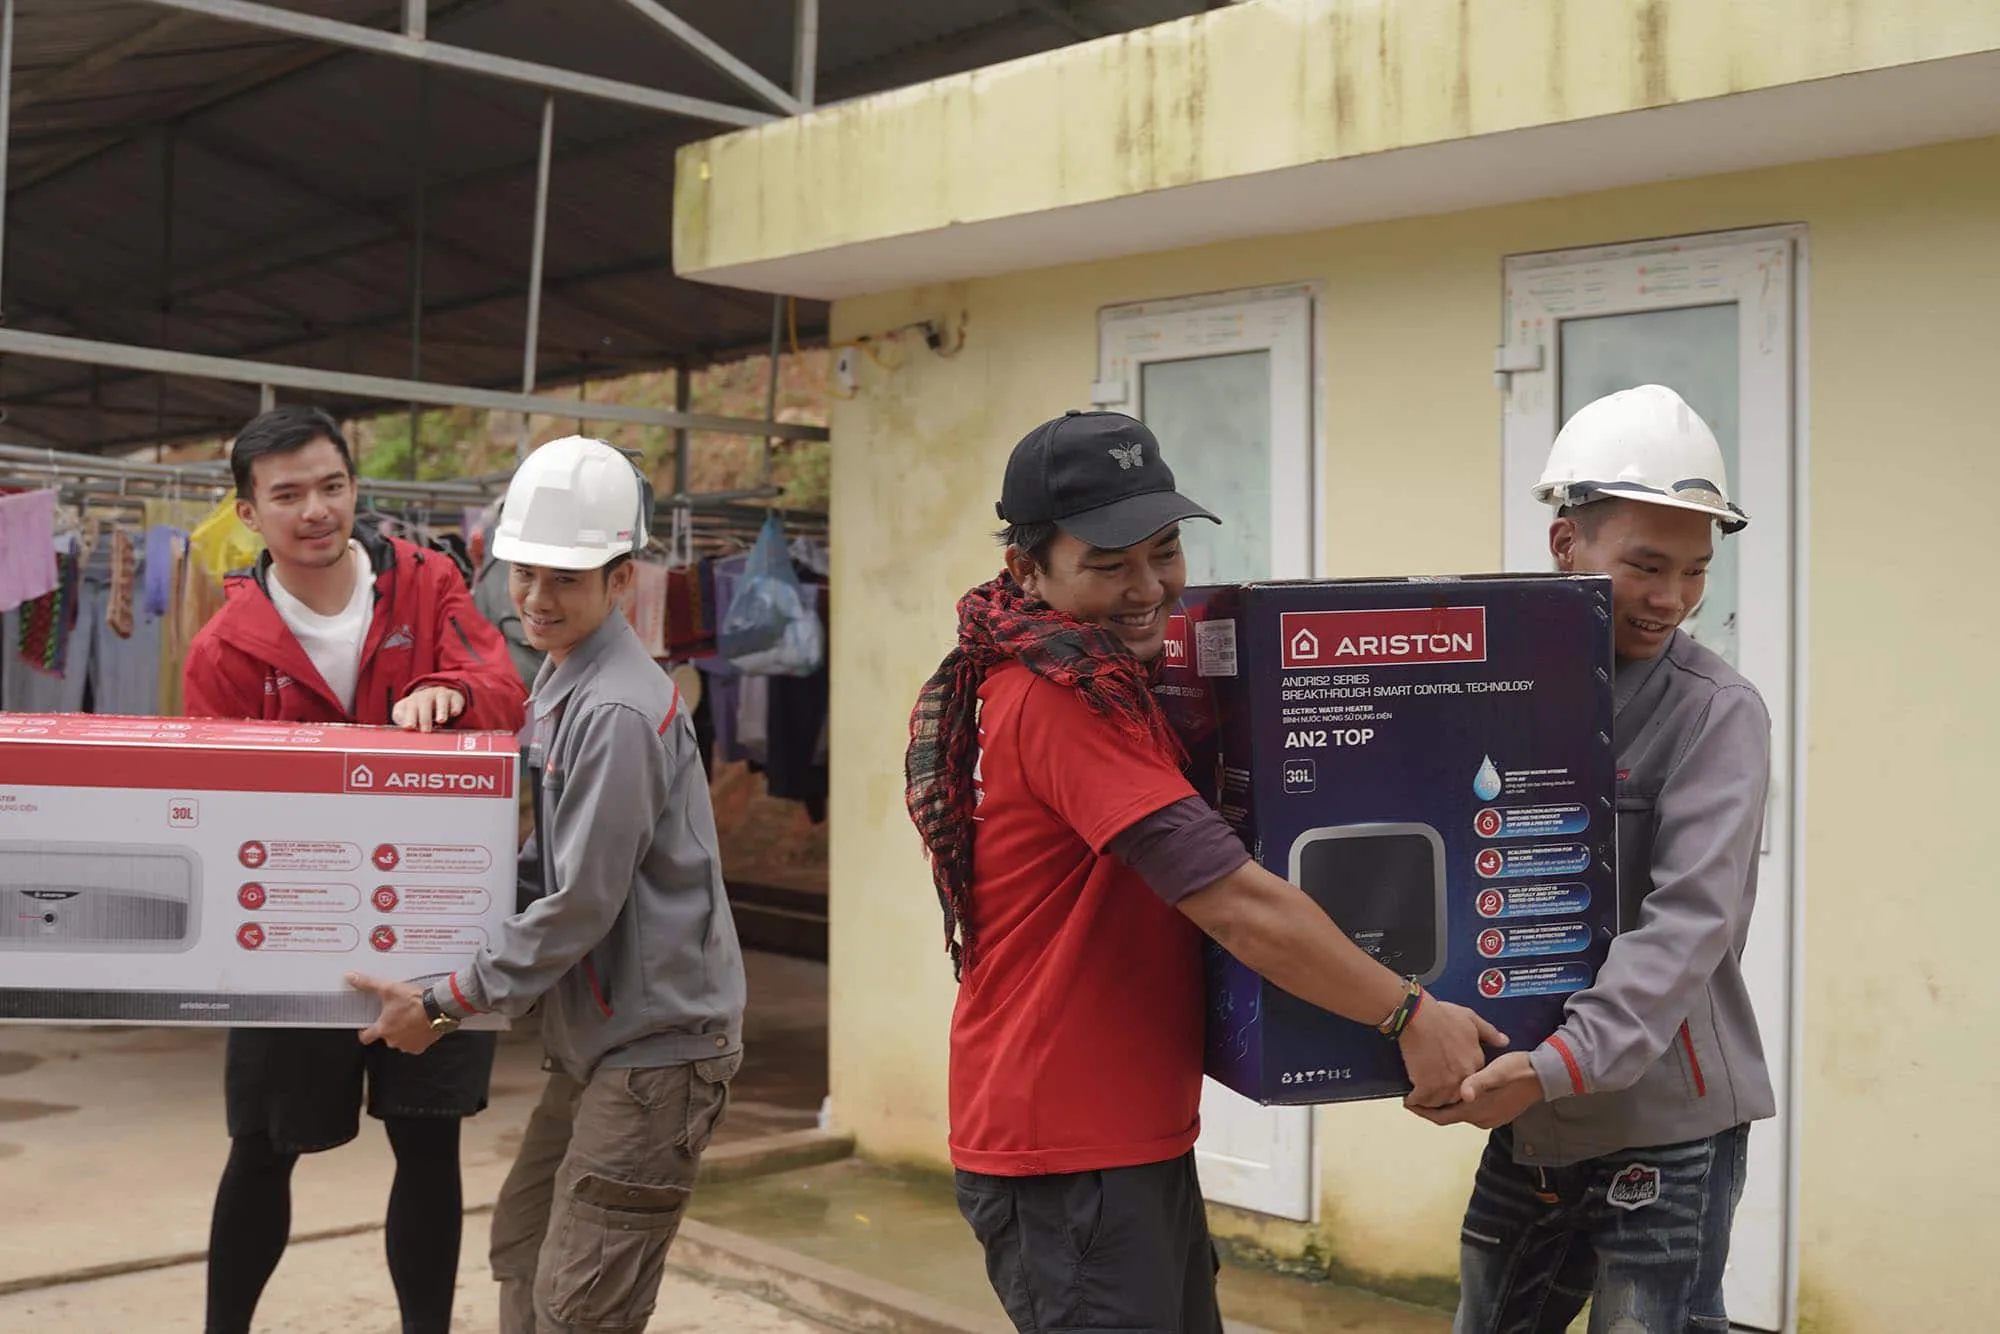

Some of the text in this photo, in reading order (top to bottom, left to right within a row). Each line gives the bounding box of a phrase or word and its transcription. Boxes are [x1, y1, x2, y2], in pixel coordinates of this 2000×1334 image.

[1334, 633, 1473, 657] ARISTON
[1281, 674, 1370, 688] ANDRIS2 SERIES
[1282, 680, 1534, 701] BREAKTHROUGH SMART CONTROL TECHNOLOGY
[1282, 704, 1374, 716] ELECTRIC WATER HEATER
[1284, 728, 1375, 749] AN2 TOP
[384, 773, 496, 790] ARISTON
[1286, 769, 1314, 784] 30L
[172, 807, 194, 820] 30L
